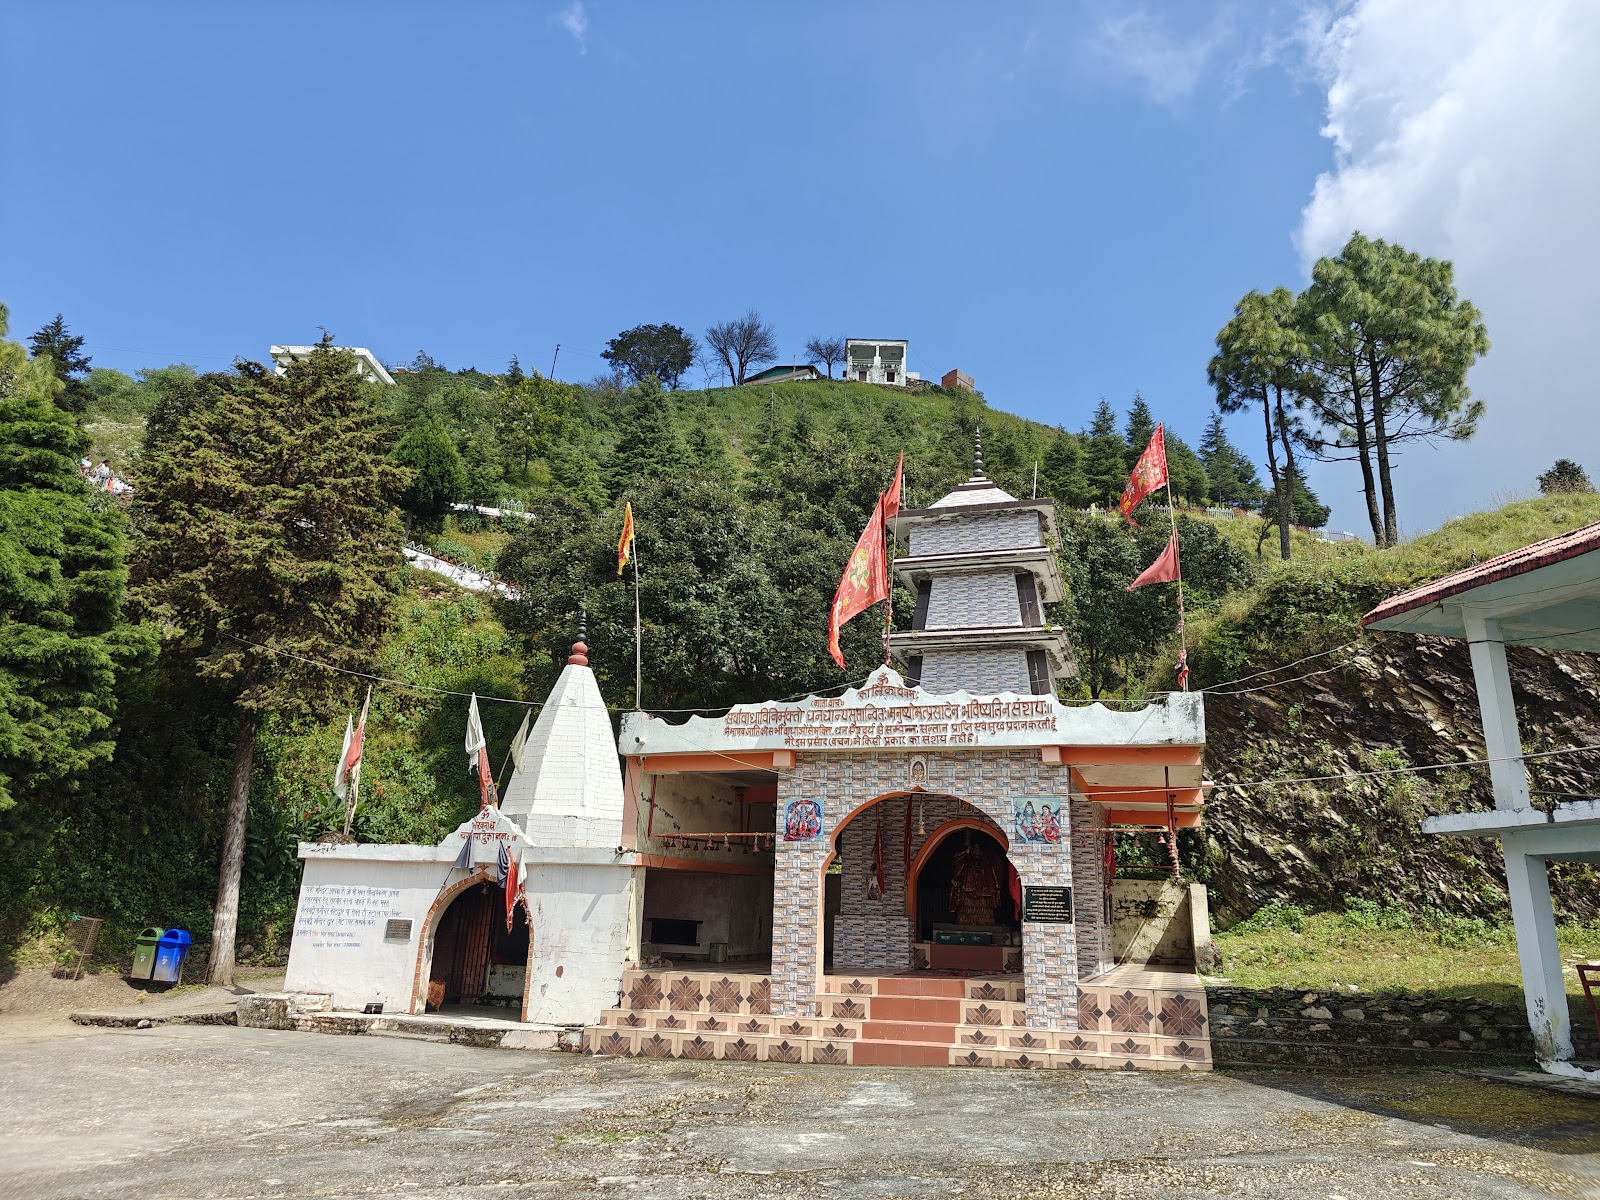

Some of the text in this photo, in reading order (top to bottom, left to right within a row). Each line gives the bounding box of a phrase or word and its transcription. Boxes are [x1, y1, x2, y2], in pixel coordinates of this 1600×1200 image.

[876, 672, 889, 686] ॐ
[877, 722, 884, 736] से
[884, 736, 907, 747] प्रकार
[908, 735, 921, 745] का
[481, 808, 490, 819] ॐ
